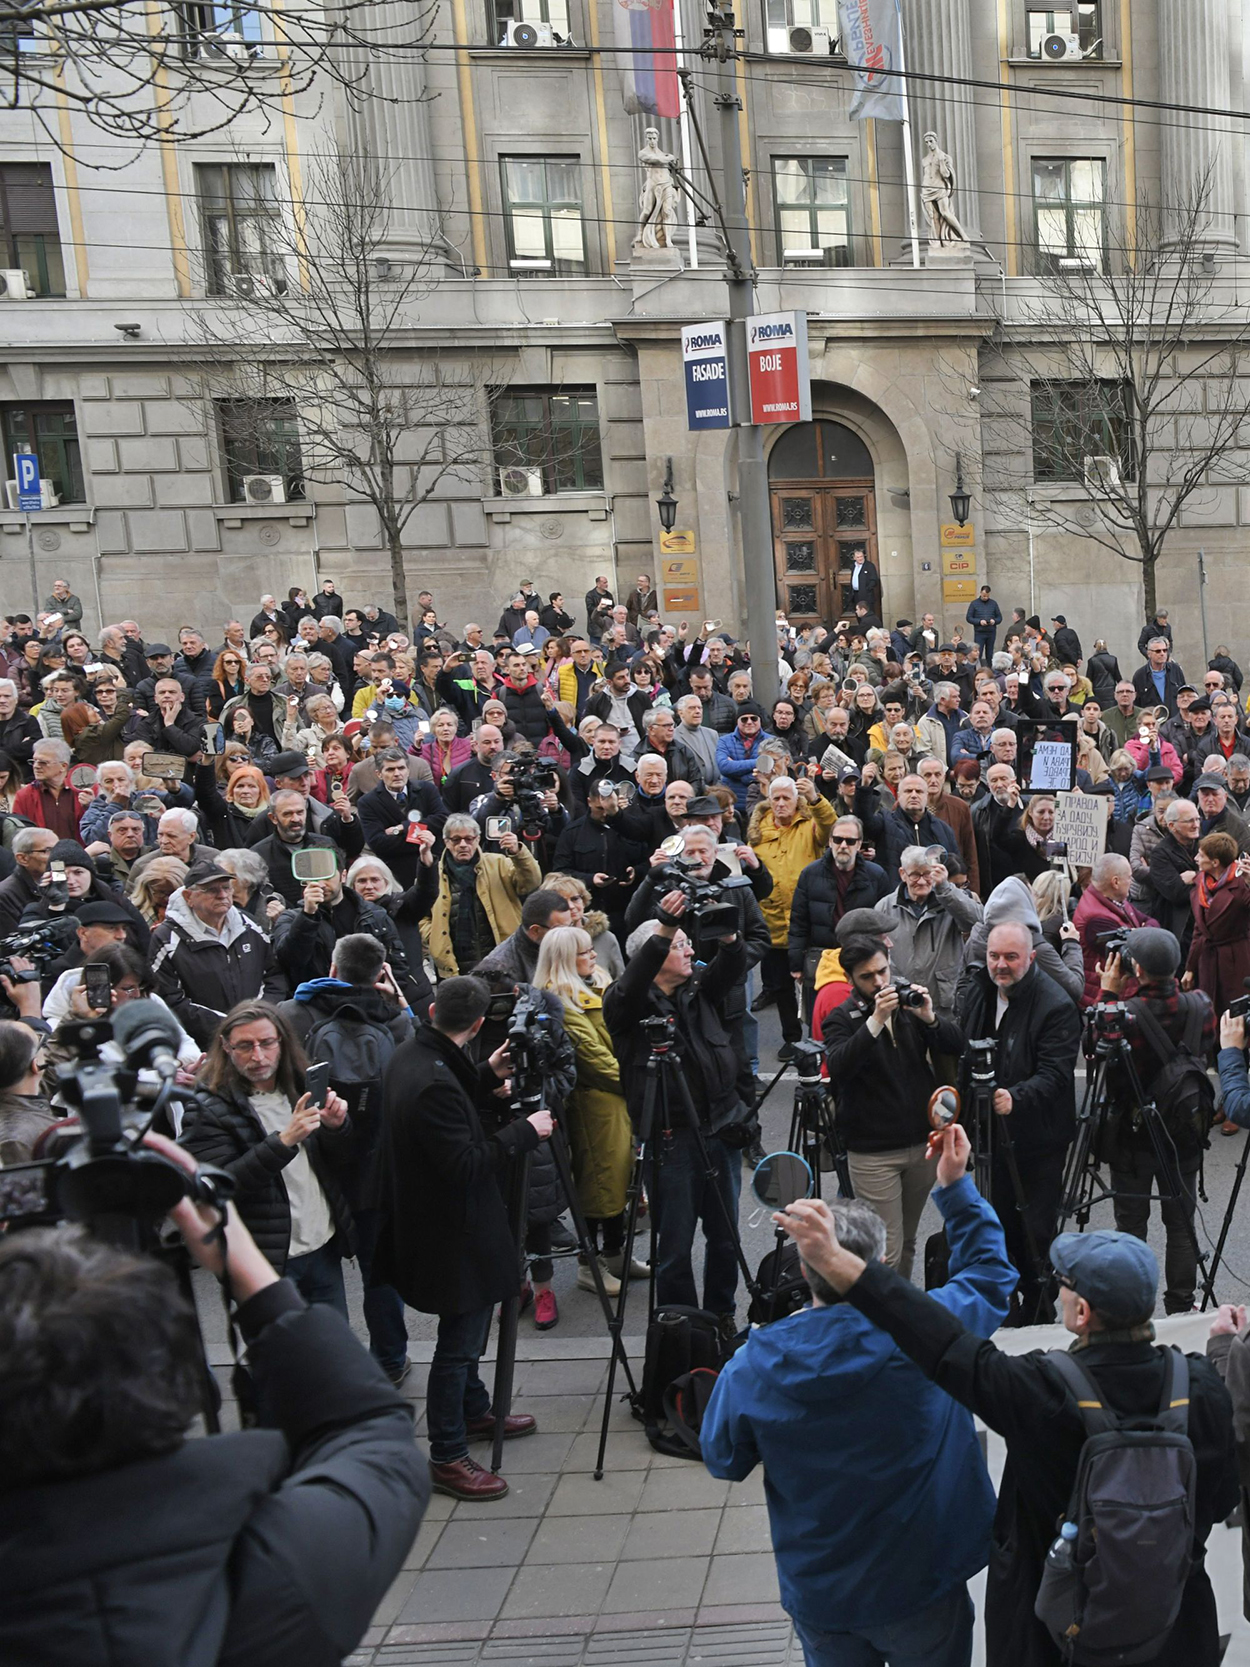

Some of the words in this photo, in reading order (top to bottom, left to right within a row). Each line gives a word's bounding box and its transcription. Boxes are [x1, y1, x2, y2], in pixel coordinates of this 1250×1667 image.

[758, 323, 793, 338] ROMA
[691, 334, 722, 347] ROMA
[759, 354, 782, 372] BOJE
[692, 363, 725, 382] FASADE
[695, 407, 727, 419] WWW.ROMA.RS
[762, 402, 798, 413] WWW.ROMA.RS
[21, 460, 35, 490] P
[1065, 796, 1099, 810] ПРАВДА
[1057, 809, 1066, 821] ЗА
[1091, 840, 1098, 852] И
